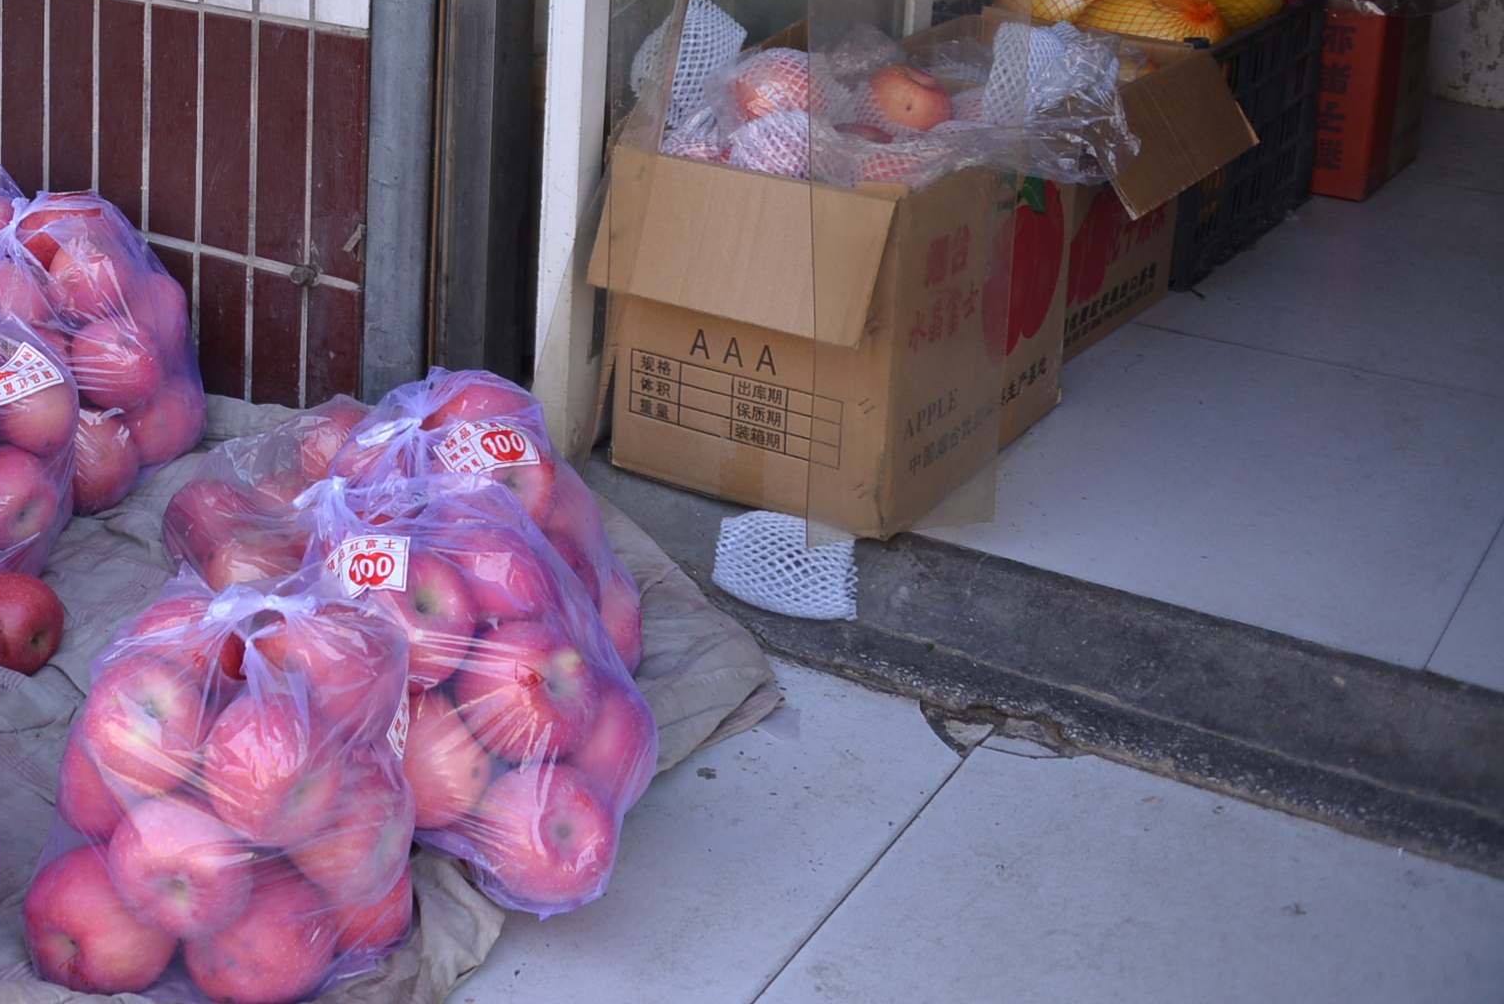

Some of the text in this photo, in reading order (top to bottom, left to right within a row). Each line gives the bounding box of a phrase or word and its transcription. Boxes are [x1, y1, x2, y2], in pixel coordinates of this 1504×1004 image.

[640, 355, 672, 377] 规格
[640, 376, 672, 399] 体积
[736, 380, 783, 405] 出库期
[639, 398, 670, 421] 重量
[735, 402, 782, 427] 保质期
[904, 388, 958, 440] APPLE
[483, 433, 524, 455] 100
[734, 424, 781, 450] 装箱期
[351, 557, 392, 583] 100
